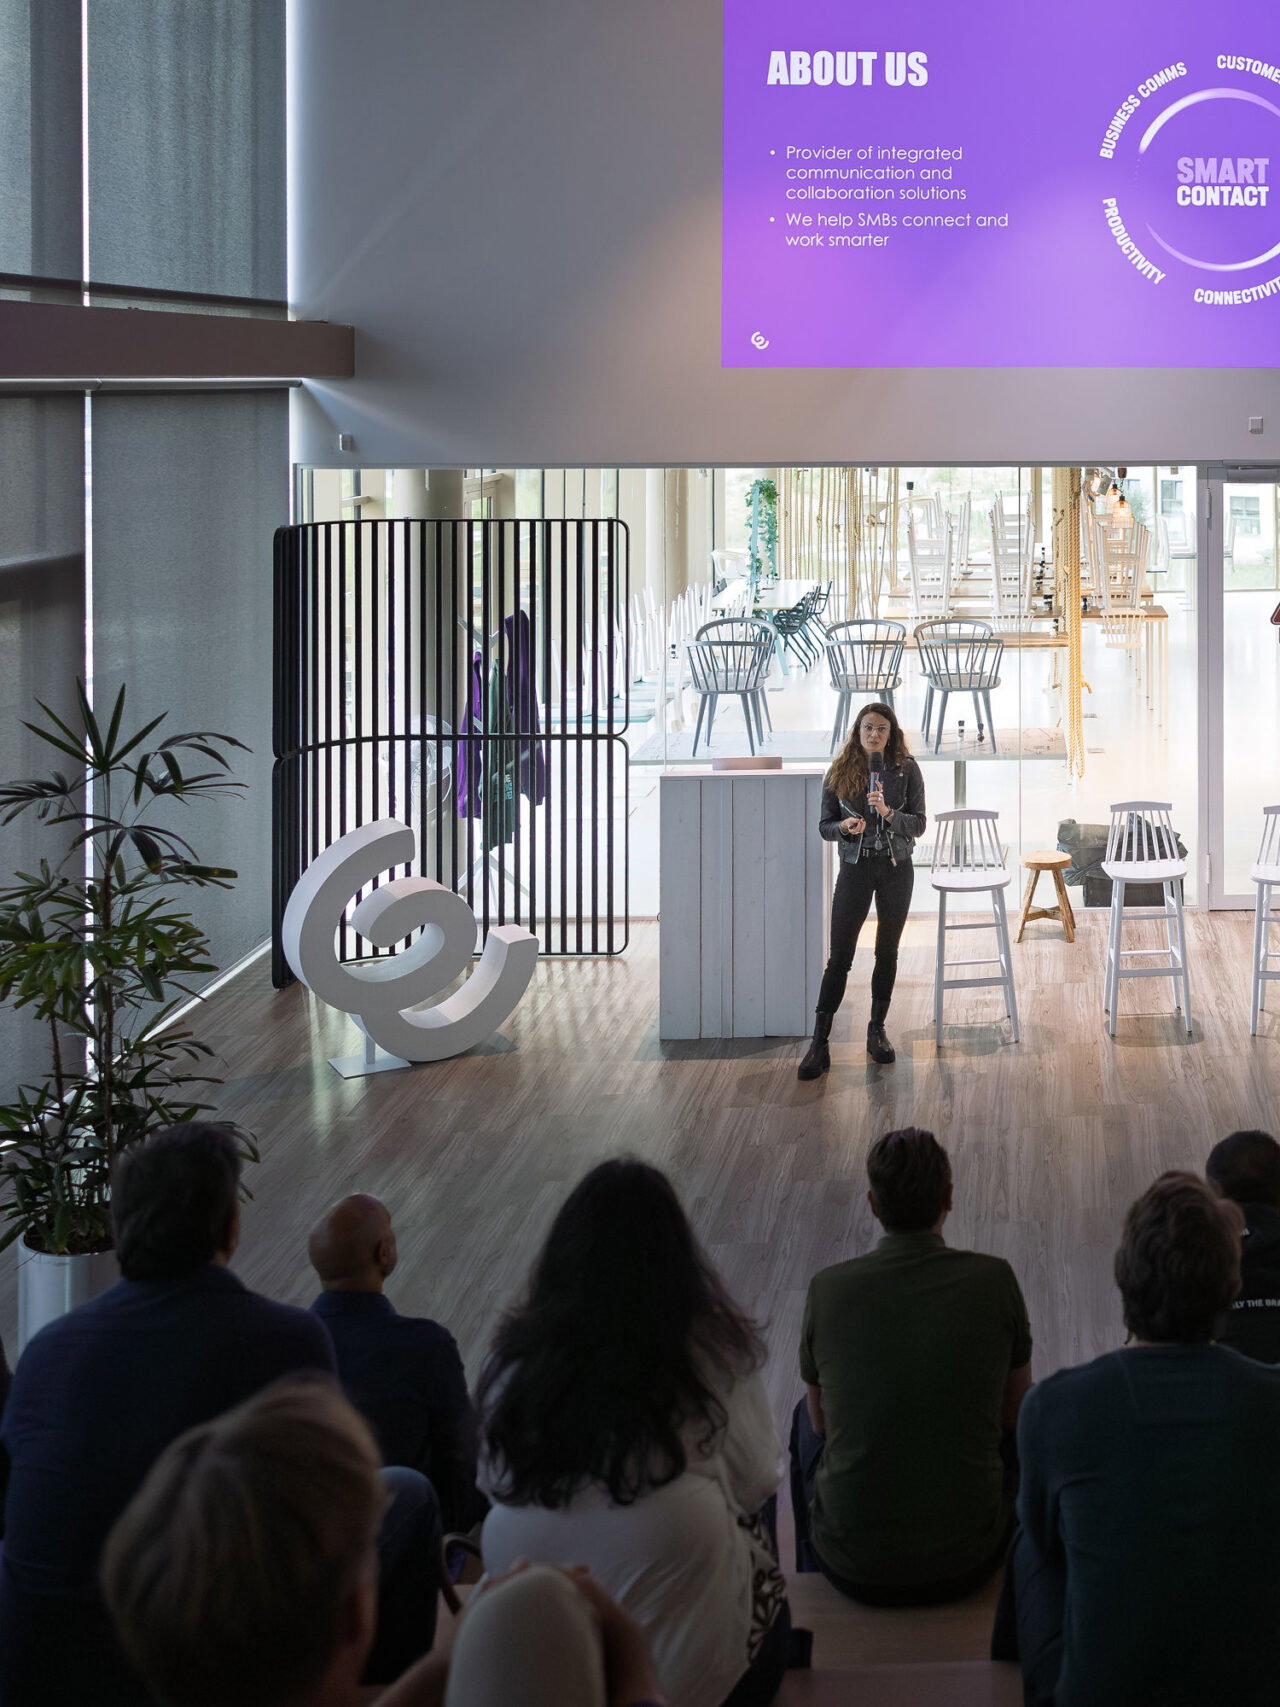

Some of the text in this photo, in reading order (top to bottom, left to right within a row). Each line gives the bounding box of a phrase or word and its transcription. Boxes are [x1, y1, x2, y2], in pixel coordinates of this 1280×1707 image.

[767, 51, 928, 87] ABOUT US
[1099, 62, 1187, 159] BUSINESS COMMS
[786, 145, 963, 163] Provider of integrated
[786, 166, 952, 180] communication and
[1176, 157, 1269, 184] SMART
[785, 185, 967, 200] collaboration solutions
[1176, 185, 1269, 207] CONTACT
[786, 212, 1009, 229] We help SMBs connect and
[785, 233, 889, 247] work smarter
[1102, 197, 1166, 285] PRODUCTIVITY
[1247, 1299, 1264, 1308] THE
